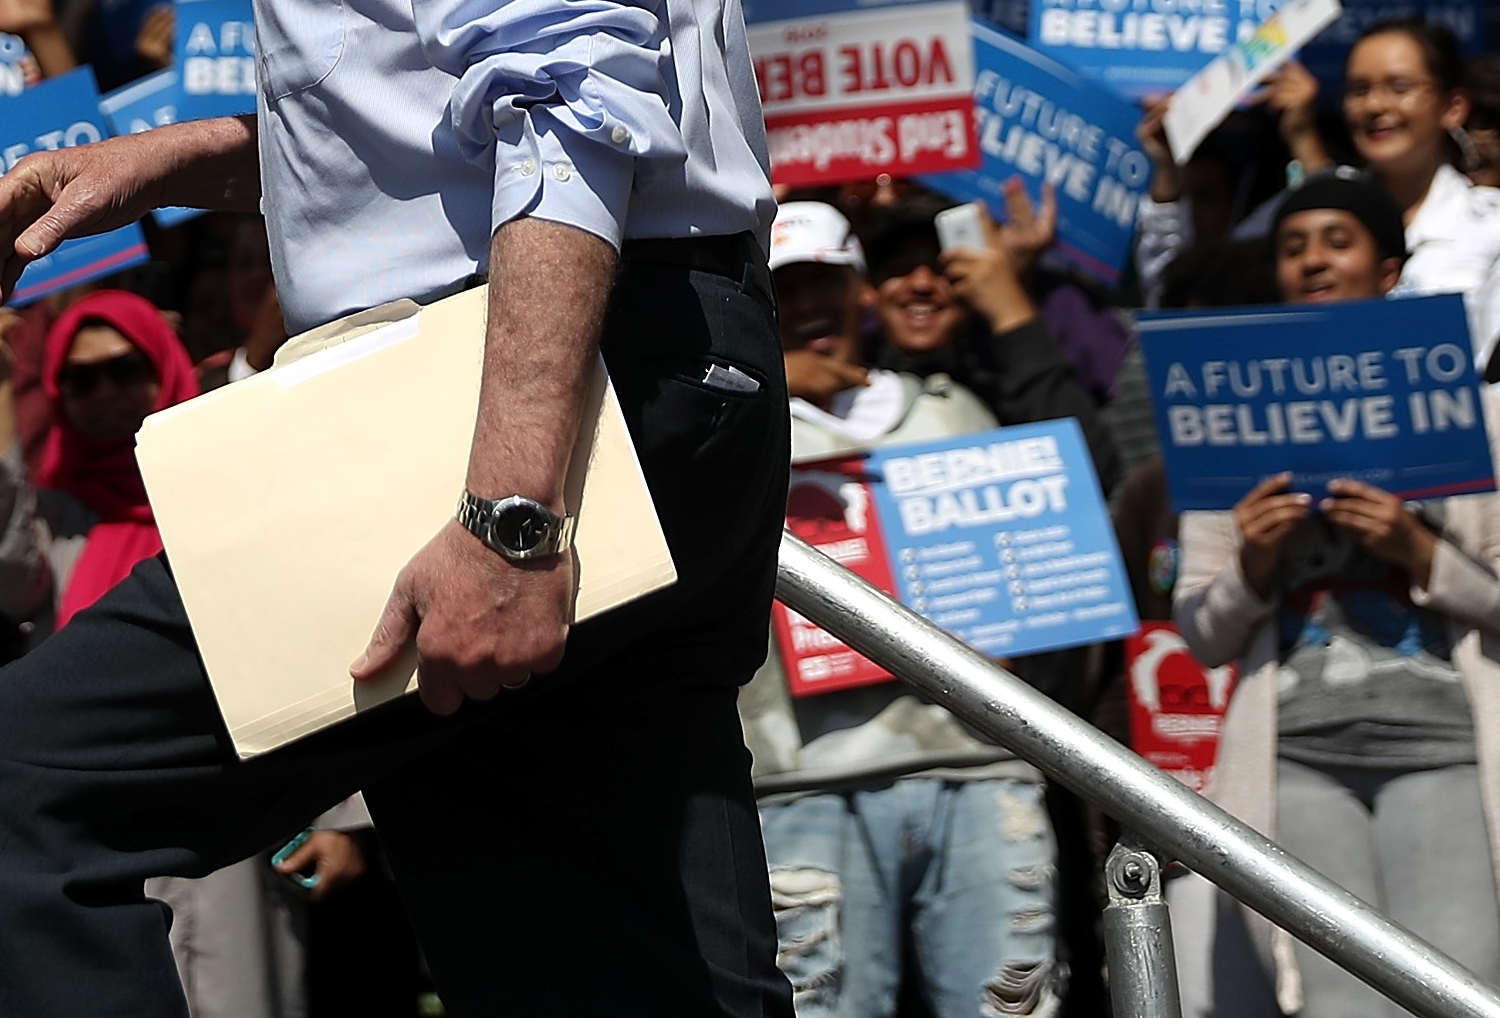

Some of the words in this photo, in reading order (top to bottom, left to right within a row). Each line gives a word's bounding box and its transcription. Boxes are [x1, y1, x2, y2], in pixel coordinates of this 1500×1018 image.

[186, 22, 217, 56] A
[1039, 8, 1230, 53] BELIEVE
[838, 34, 957, 95] VOTE
[899, 109, 967, 164] End
[975, 69, 1104, 163] FUTURE
[1106, 137, 1150, 188] TO
[976, 106, 1097, 202] LIEVE
[1164, 361, 1197, 399] A
[1201, 351, 1388, 399] FUTURE
[1392, 343, 1468, 384] TO
[1167, 395, 1399, 447] BELIEVE
[1408, 385, 1477, 434] IN
[899, 474, 1069, 537] BALLOT
